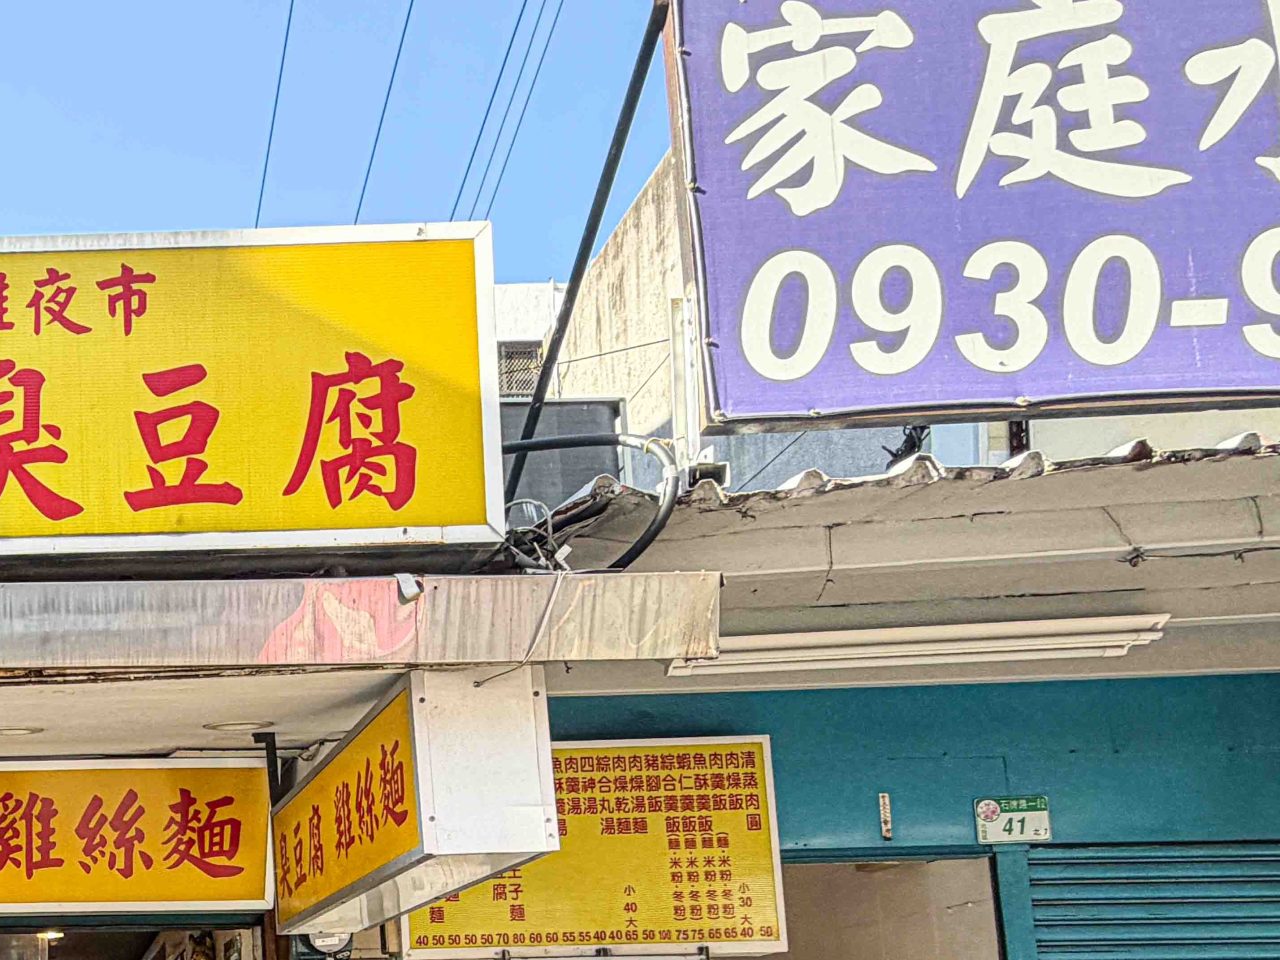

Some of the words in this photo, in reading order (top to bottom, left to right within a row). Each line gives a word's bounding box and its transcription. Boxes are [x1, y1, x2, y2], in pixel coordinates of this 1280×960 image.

[278, 804, 325, 900] 臭豆腐
[332, 738, 410, 859] 雞絲麵
[1002, 816, 1026, 835] 41
